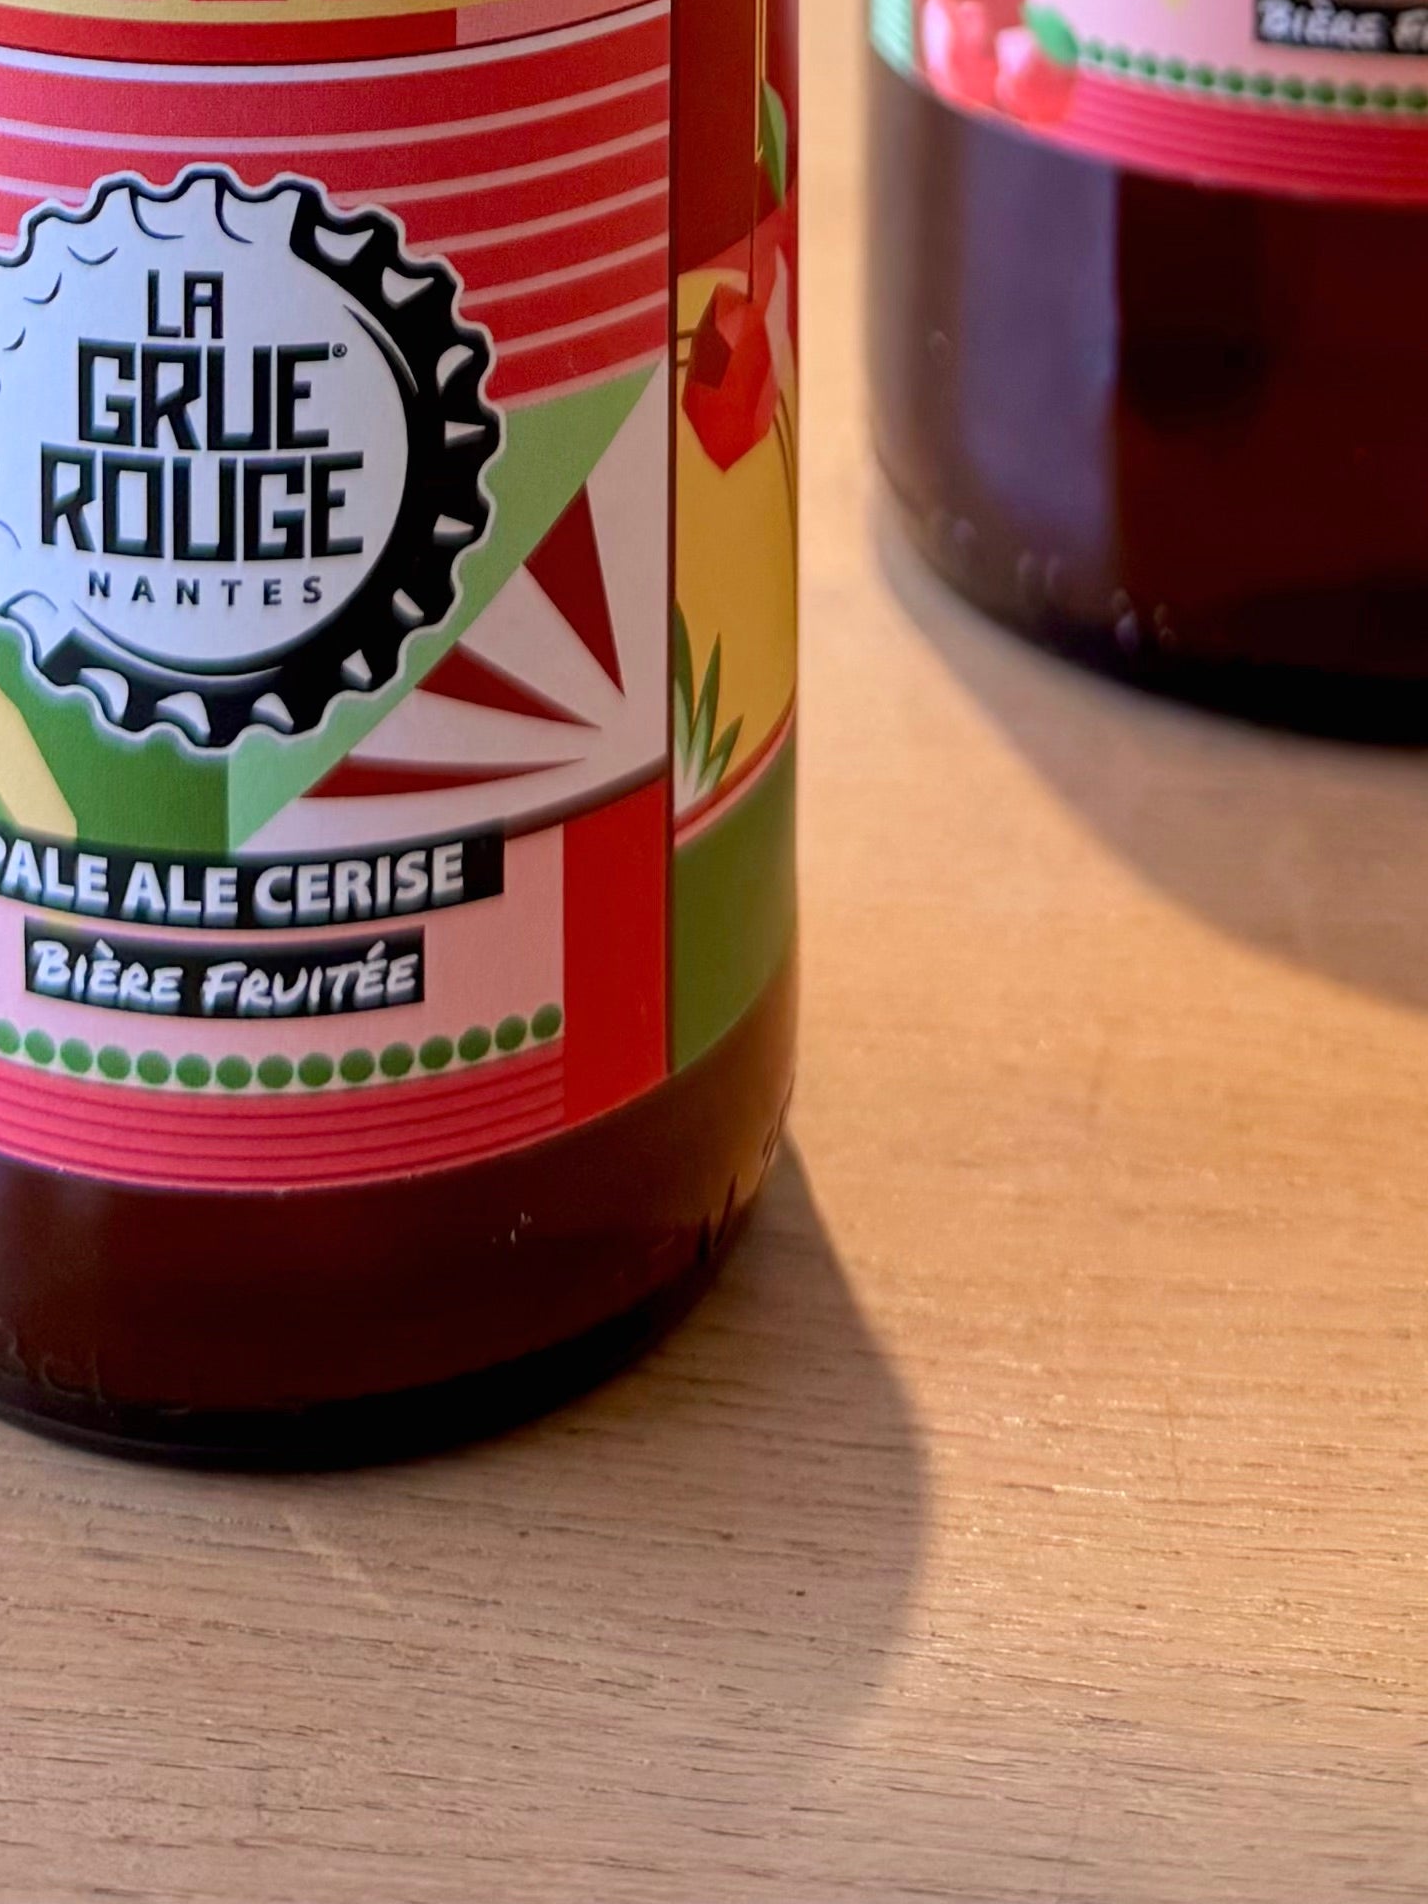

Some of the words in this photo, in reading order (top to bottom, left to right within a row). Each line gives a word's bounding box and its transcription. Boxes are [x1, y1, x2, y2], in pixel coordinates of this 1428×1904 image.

[147, 269, 223, 339] LA
[78, 338, 329, 451] GRUE
[40, 442, 363, 561] ROUGE
[88, 569, 323, 606] NANTES
[121, 861, 239, 925] ALE
[252, 842, 465, 925] CERISE
